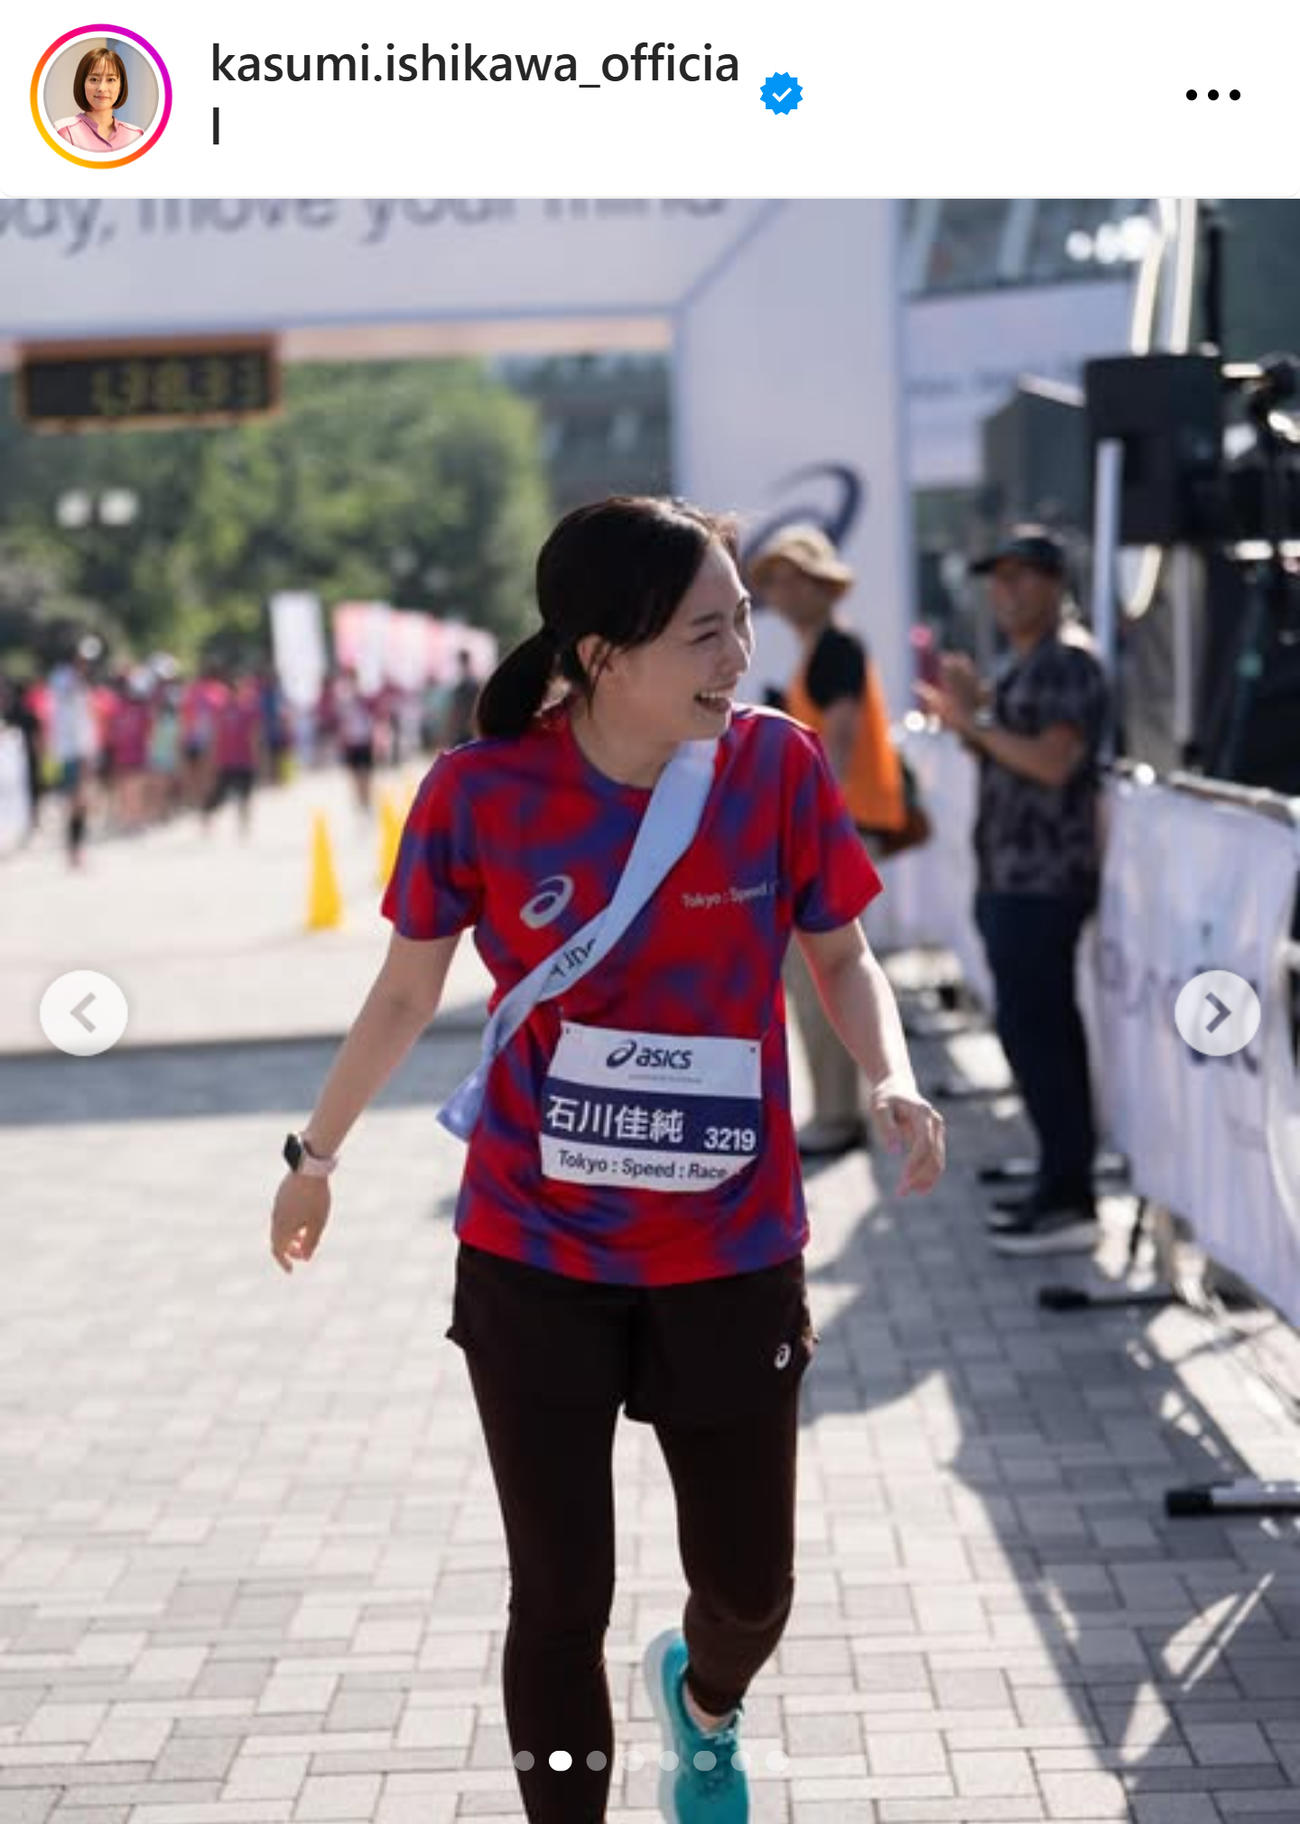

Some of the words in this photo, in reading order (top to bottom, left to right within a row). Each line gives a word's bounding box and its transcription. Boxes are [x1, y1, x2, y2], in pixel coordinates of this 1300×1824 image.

[545, 1095, 685, 1144] 石川佳純
[703, 1125, 757, 1151] 3219
[557, 1149, 608, 1175] Tokyo
[621, 1157, 676, 1179] Speed
[687, 1162, 727, 1179] Race
